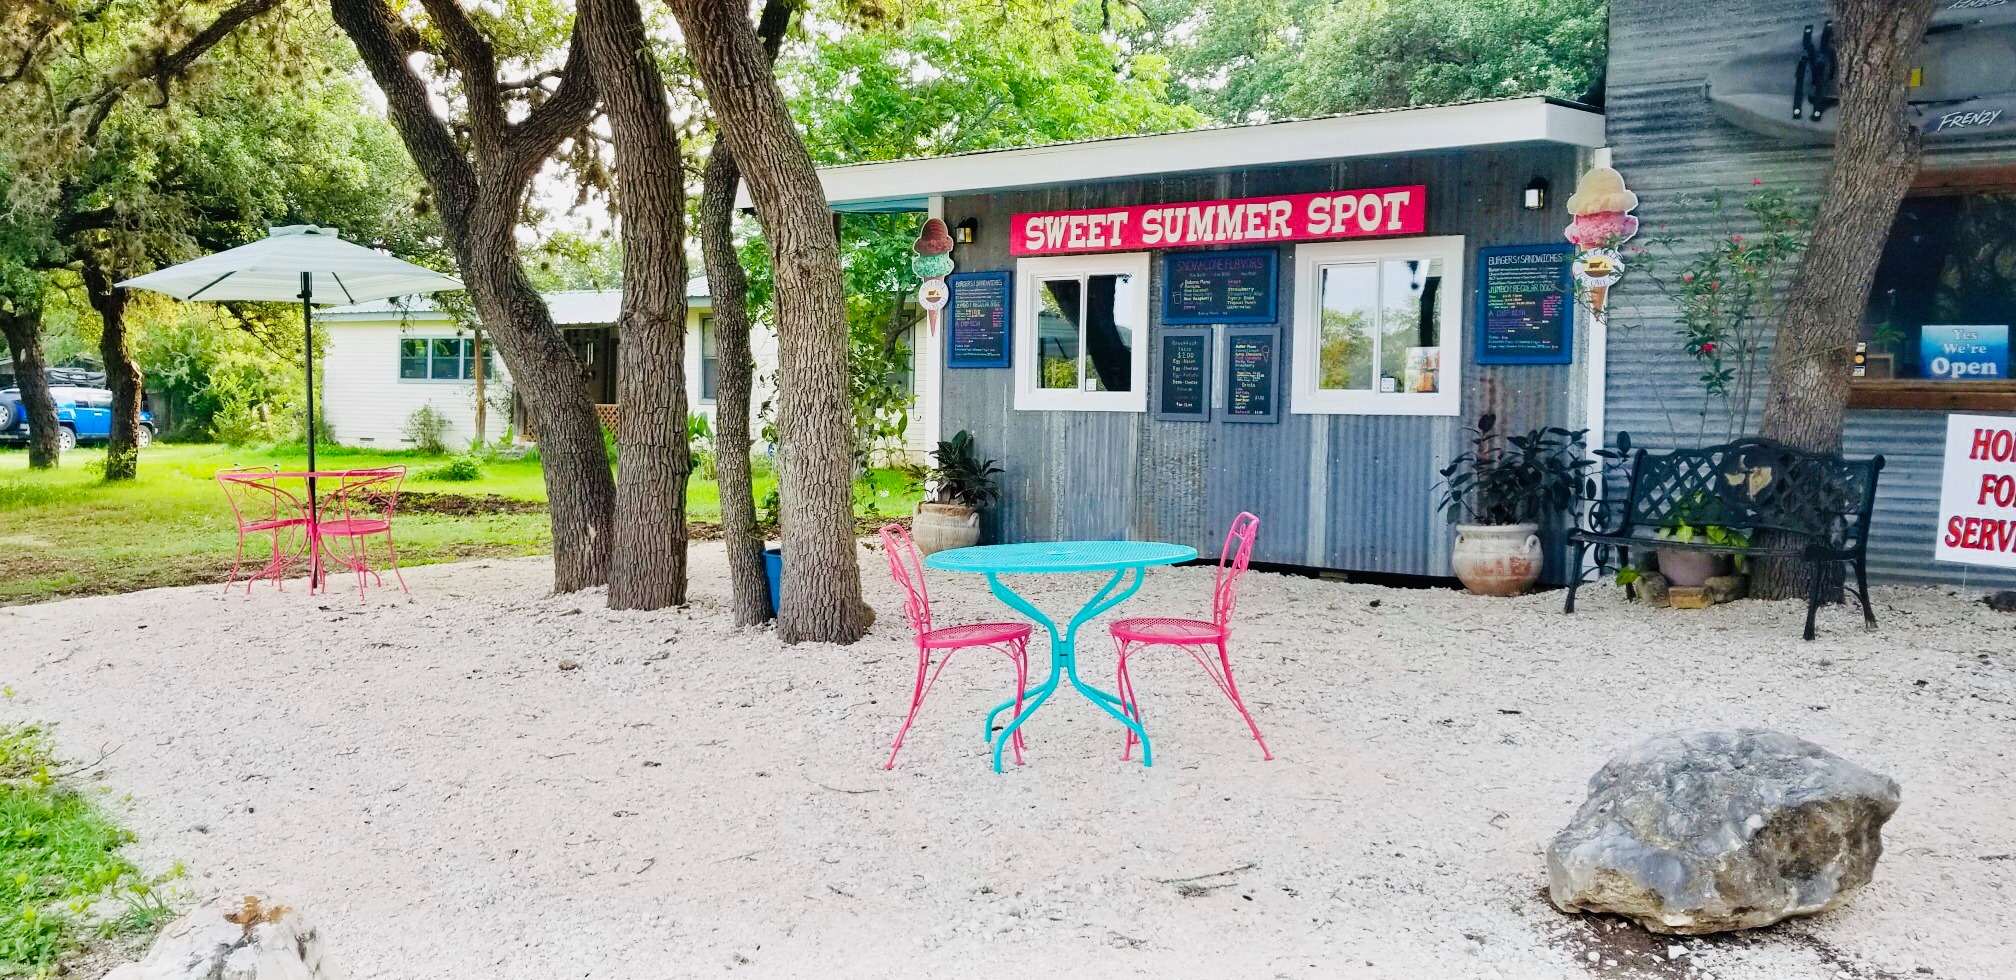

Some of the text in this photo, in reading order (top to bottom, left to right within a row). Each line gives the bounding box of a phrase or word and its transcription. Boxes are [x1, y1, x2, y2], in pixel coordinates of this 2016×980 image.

[1937, 109, 2003, 132] FRENZY
[1025, 191, 1411, 250] SWEET SUMMER SPOT
[1942, 343, 1987, 354] We're
[1952, 329, 1978, 340] Yes
[1931, 357, 1997, 378] Open
[1969, 428, 2016, 462] HO
[1977, 473, 2016, 508] FO
[1944, 515, 2016, 553] SERV
